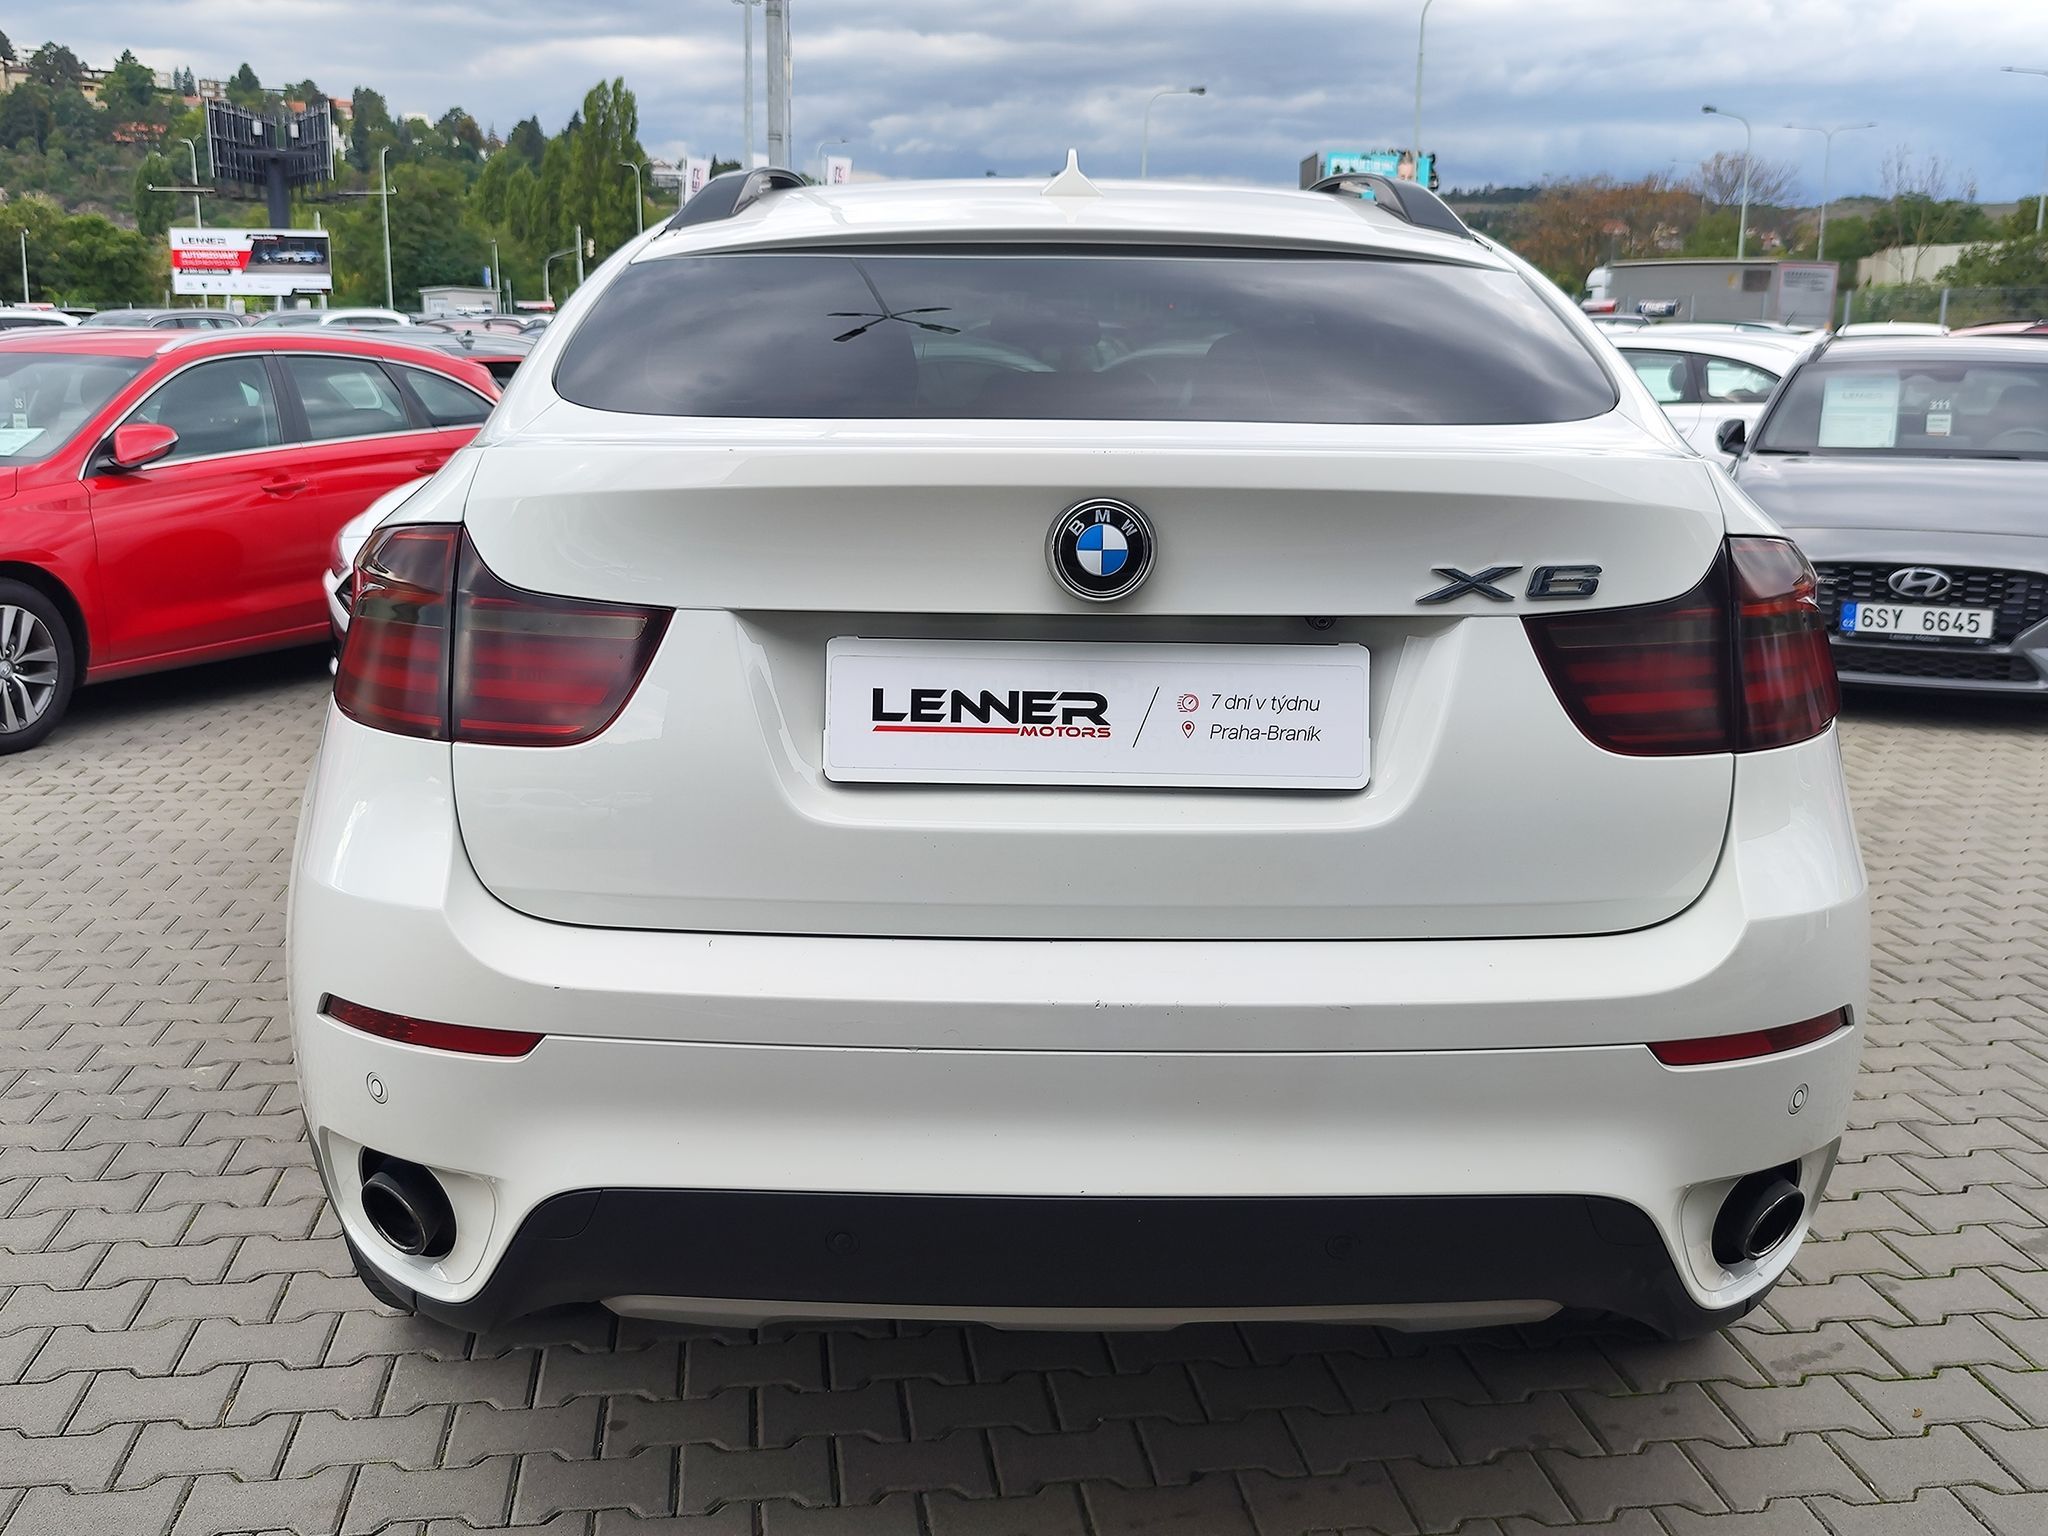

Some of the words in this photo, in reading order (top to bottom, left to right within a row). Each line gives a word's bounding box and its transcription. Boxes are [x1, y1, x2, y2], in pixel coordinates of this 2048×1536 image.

[1068, 509, 1138, 537] BMW
[1415, 564, 1603, 605] X6
[1861, 607, 1903, 629] 6SY
[1922, 610, 1982, 634] 6645
[872, 687, 1111, 727] LENNER
[1211, 693, 1222, 710] 7
[1224, 694, 1254, 711] dní
[1256, 698, 1267, 710] v
[1271, 694, 1321, 715] týdnu
[1020, 725, 1112, 738] MOTORS
[1209, 723, 1322, 742] Praha-Braník
